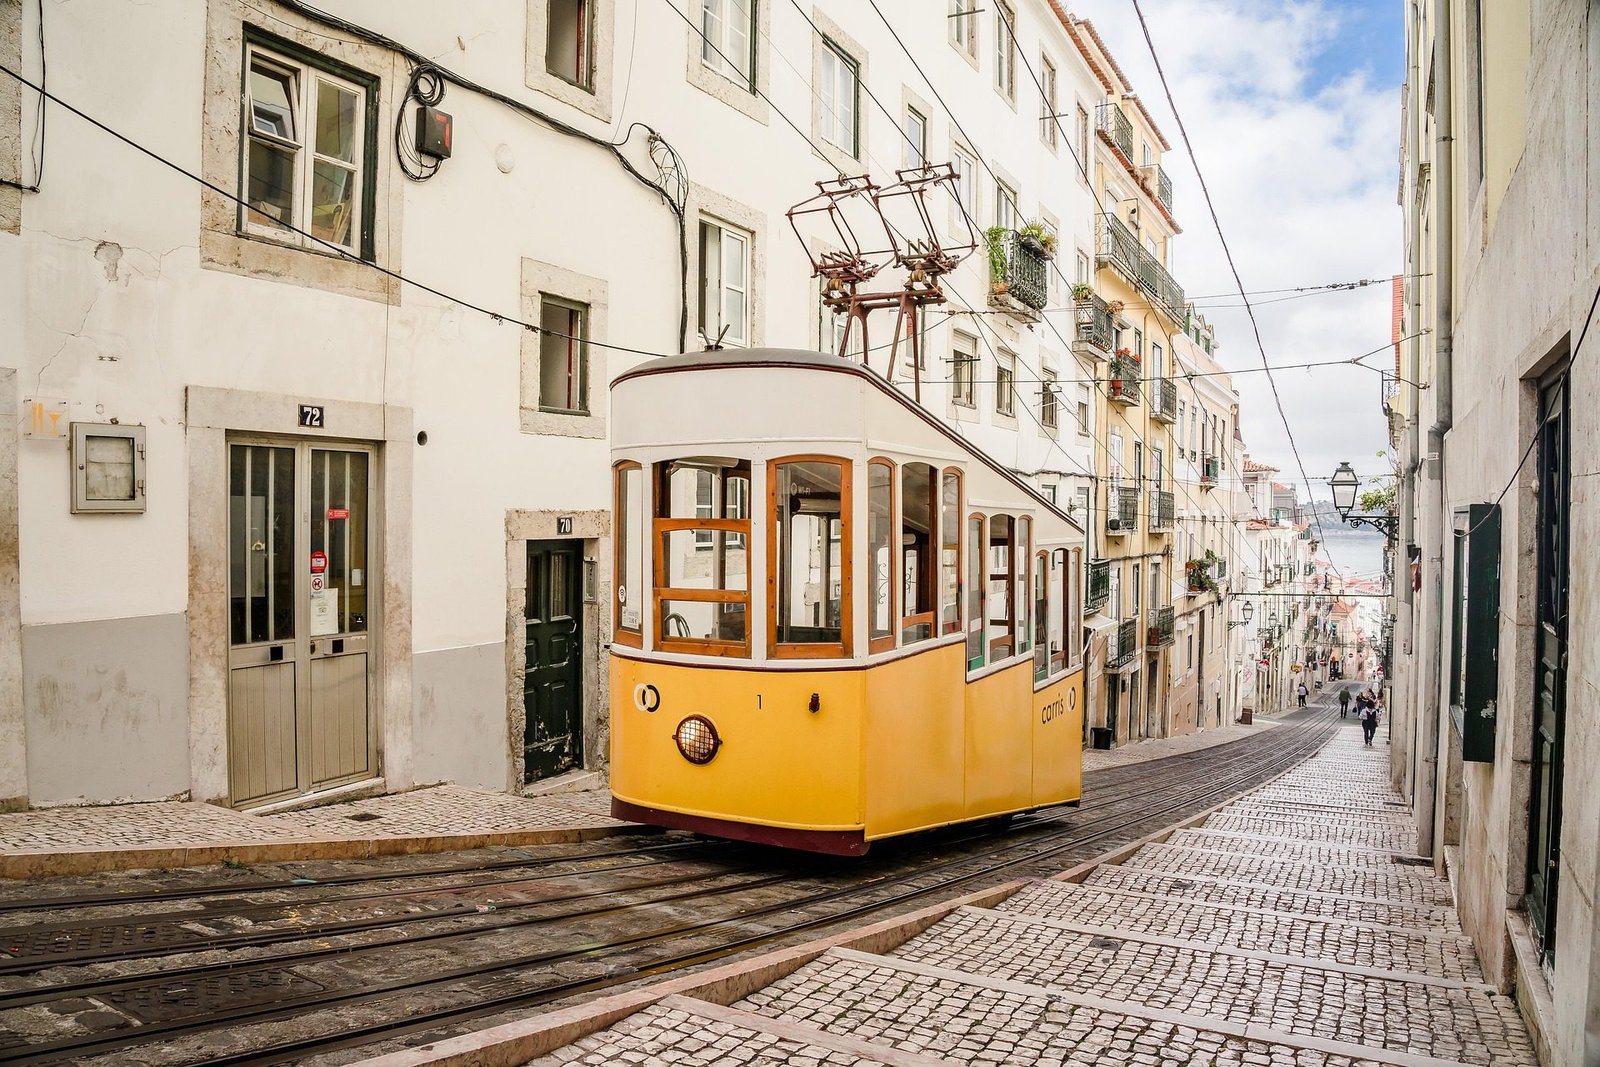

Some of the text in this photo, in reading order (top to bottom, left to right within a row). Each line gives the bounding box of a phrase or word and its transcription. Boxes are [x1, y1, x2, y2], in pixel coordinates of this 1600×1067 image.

[303, 406, 320, 426] 72
[560, 518, 571, 533] 70
[756, 694, 762, 710] 1
[1041, 692, 1064, 724] carris
